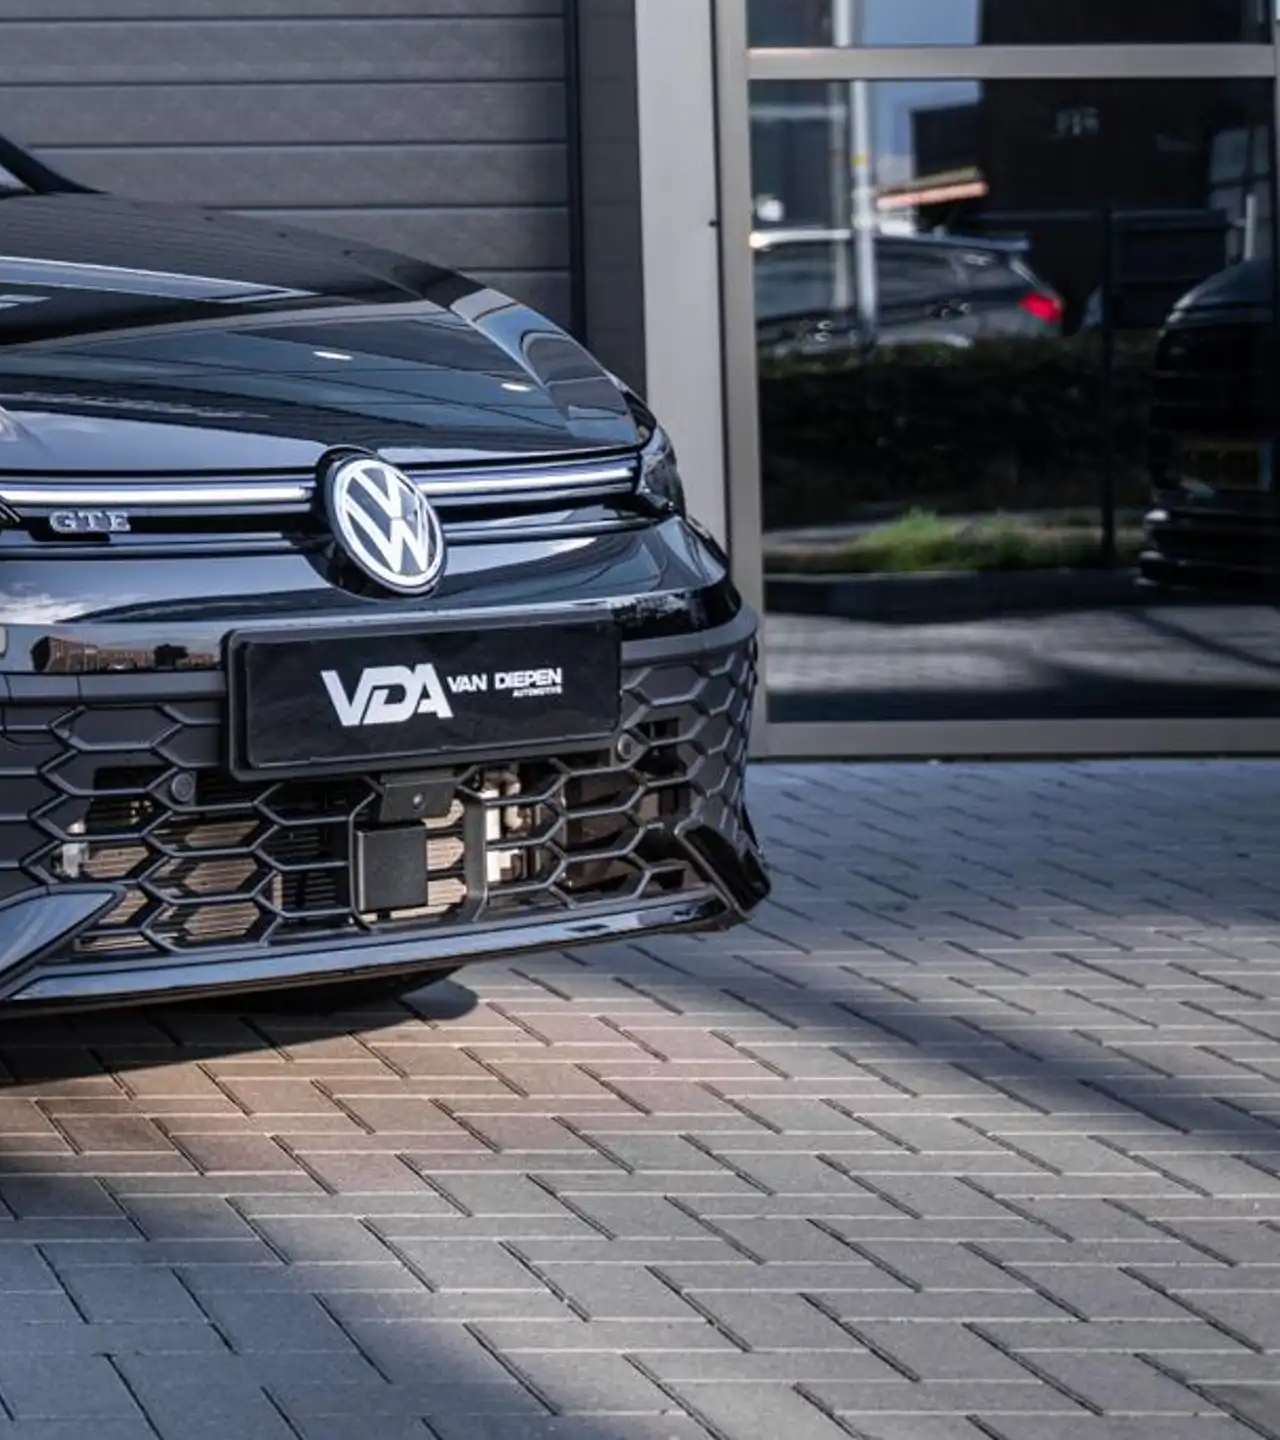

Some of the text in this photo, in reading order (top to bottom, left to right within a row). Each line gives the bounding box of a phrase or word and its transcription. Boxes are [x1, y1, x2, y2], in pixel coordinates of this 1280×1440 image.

[49, 511, 131, 532] GTE
[447, 667, 562, 693] VAN DIEPEN
[321, 663, 454, 726] VDA
